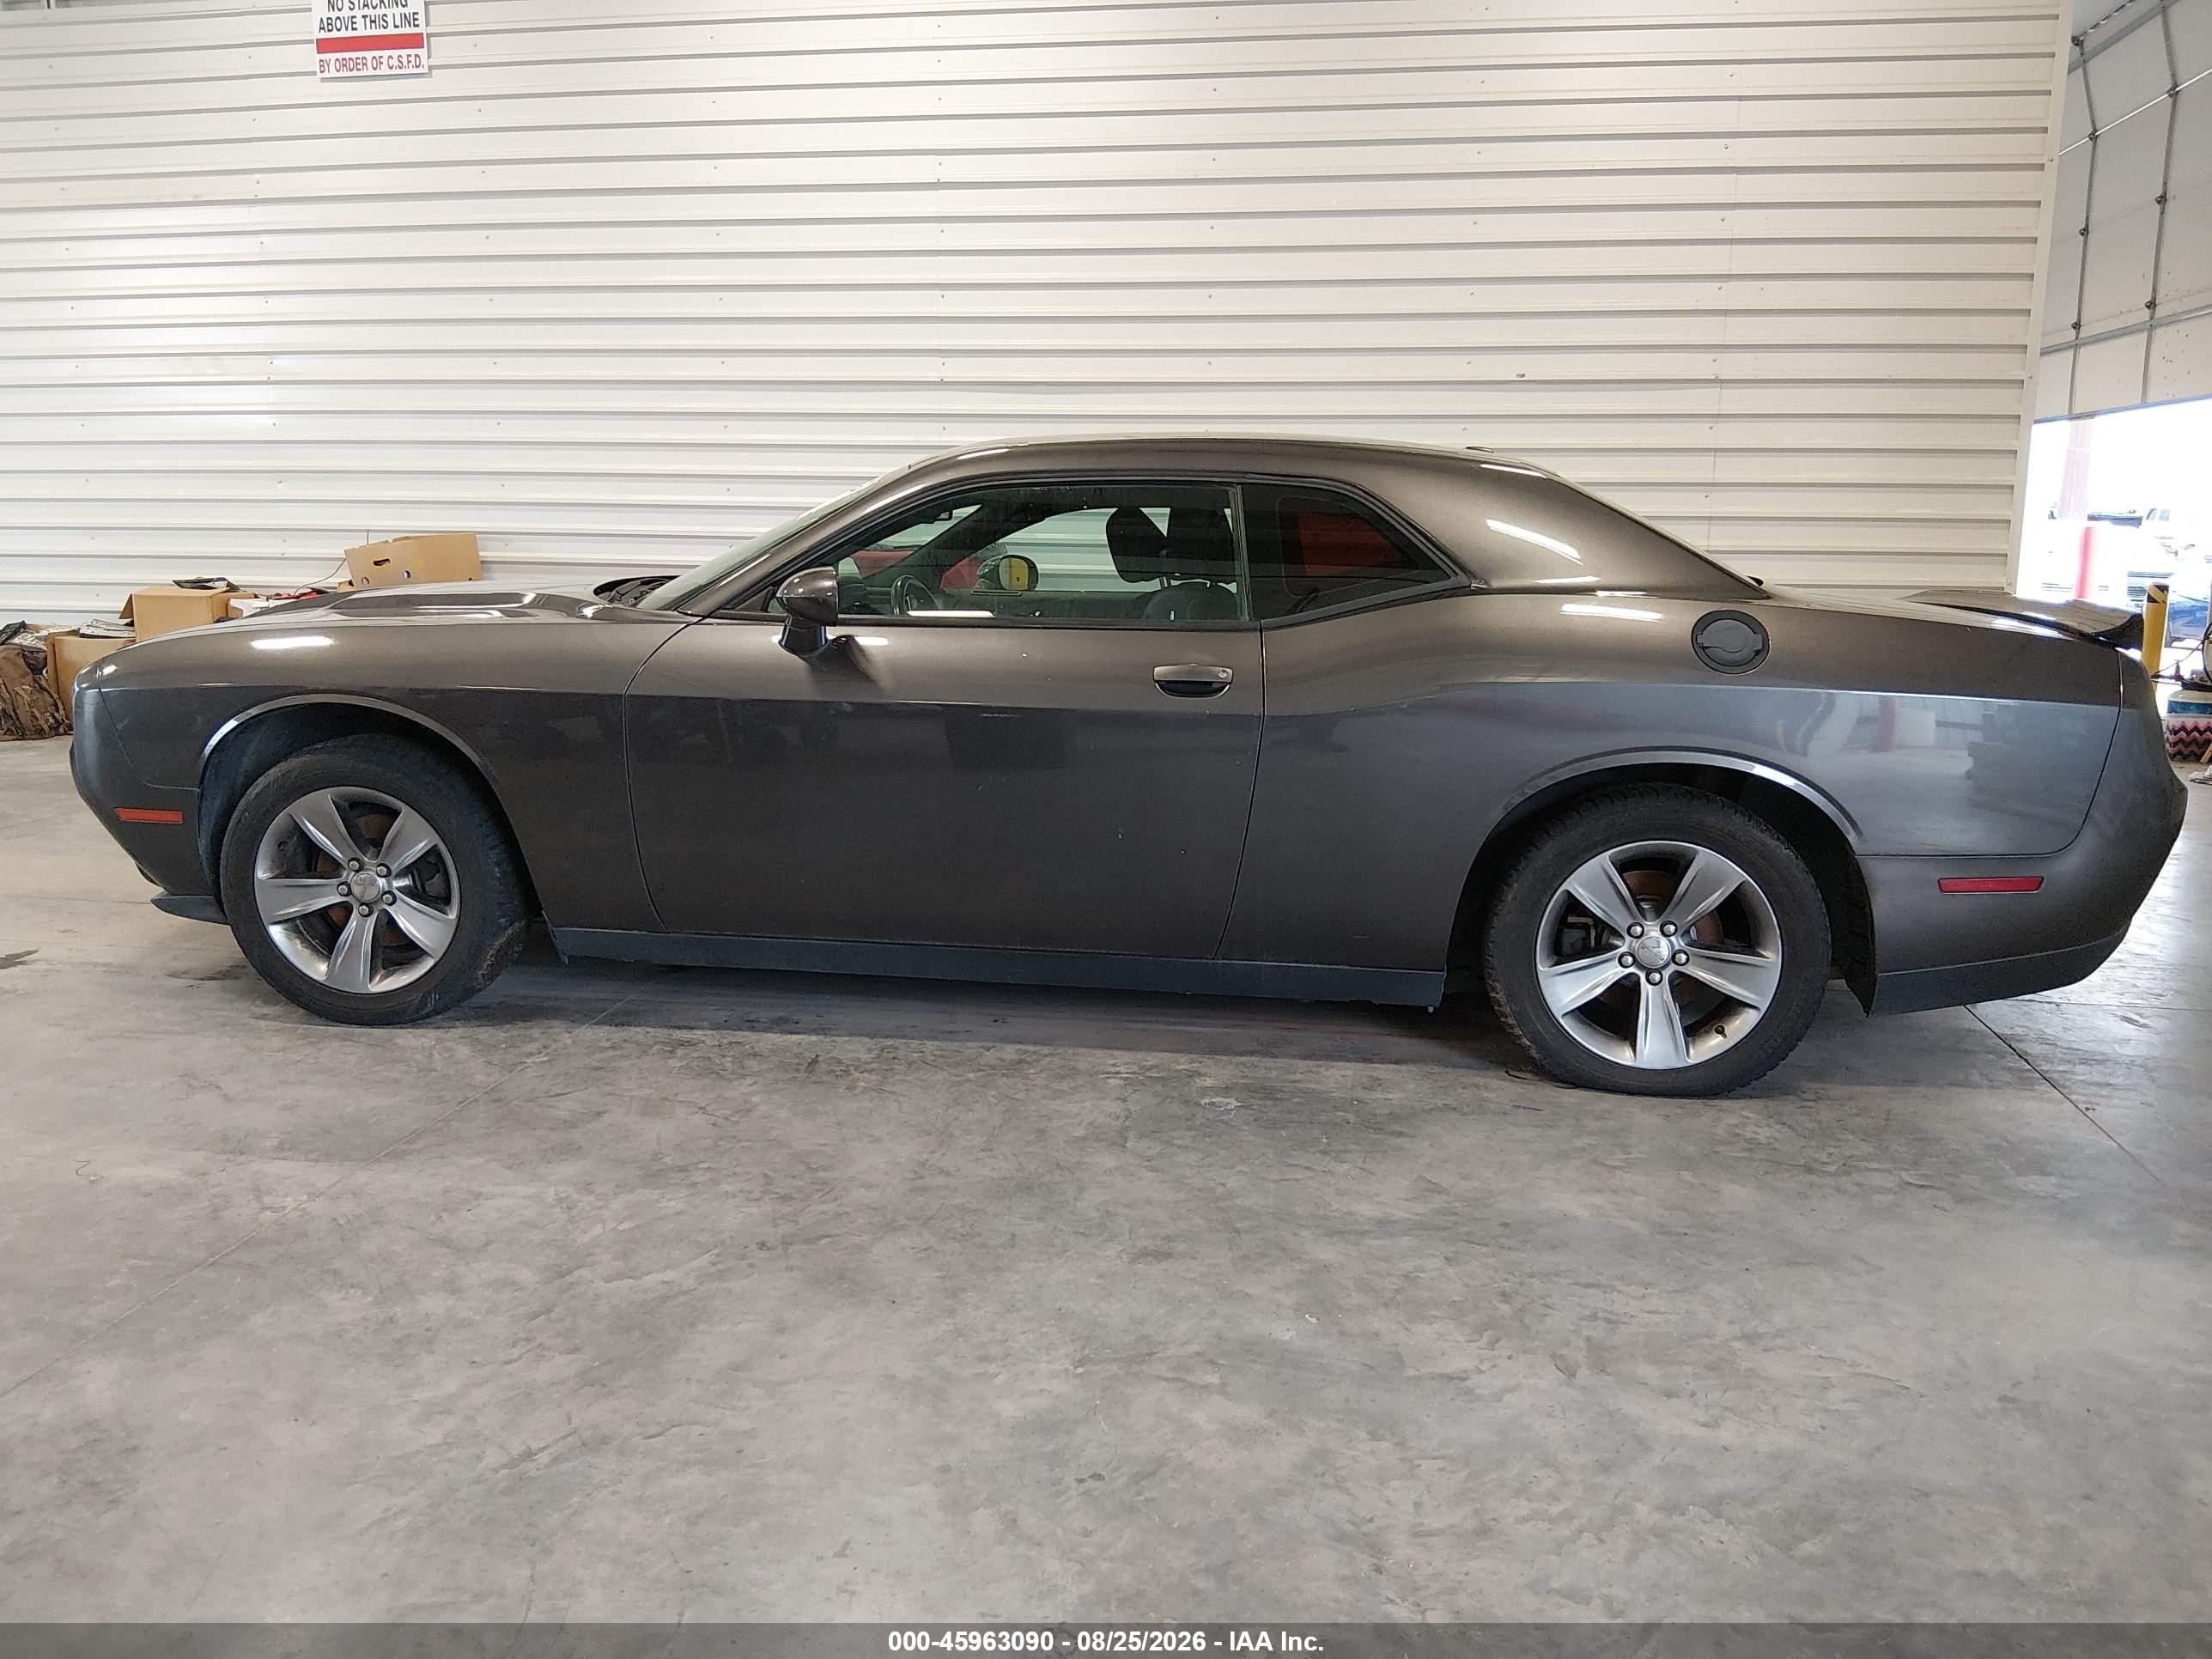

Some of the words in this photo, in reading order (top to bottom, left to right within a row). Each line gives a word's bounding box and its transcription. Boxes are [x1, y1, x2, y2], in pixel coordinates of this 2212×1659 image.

[327, 0, 344, 12] NO
[318, 15, 358, 33] ABOVE
[362, 13, 389, 31] THIS
[392, 11, 420, 29] LINE
[319, 58, 331, 74] BY
[334, 56, 368, 72] ORDER
[371, 56, 384, 70] OF
[386, 53, 425, 70] C.S.F.D.
